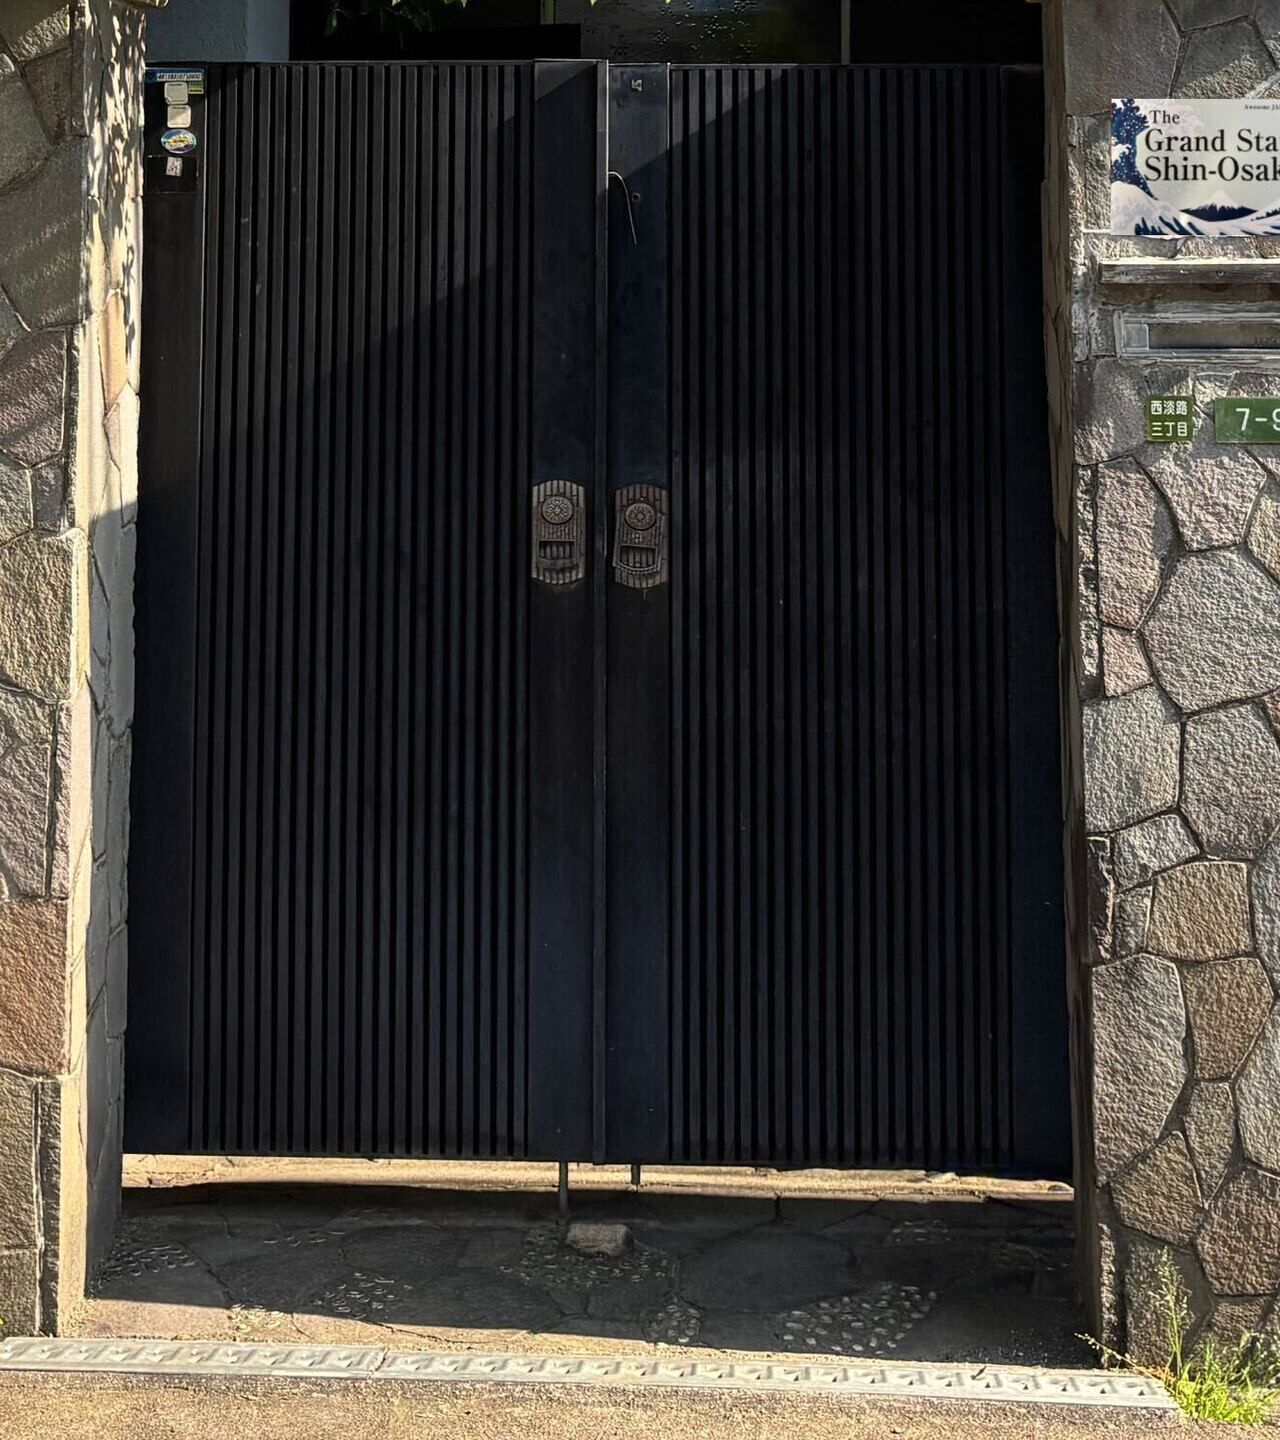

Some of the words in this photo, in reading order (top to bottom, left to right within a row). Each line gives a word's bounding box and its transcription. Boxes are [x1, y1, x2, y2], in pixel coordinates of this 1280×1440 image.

[1149, 110, 1180, 124] The
[1145, 129, 1227, 152] Grand
[1150, 400, 1188, 416] 西淡路
[1151, 422, 1188, 437] 三丁目
